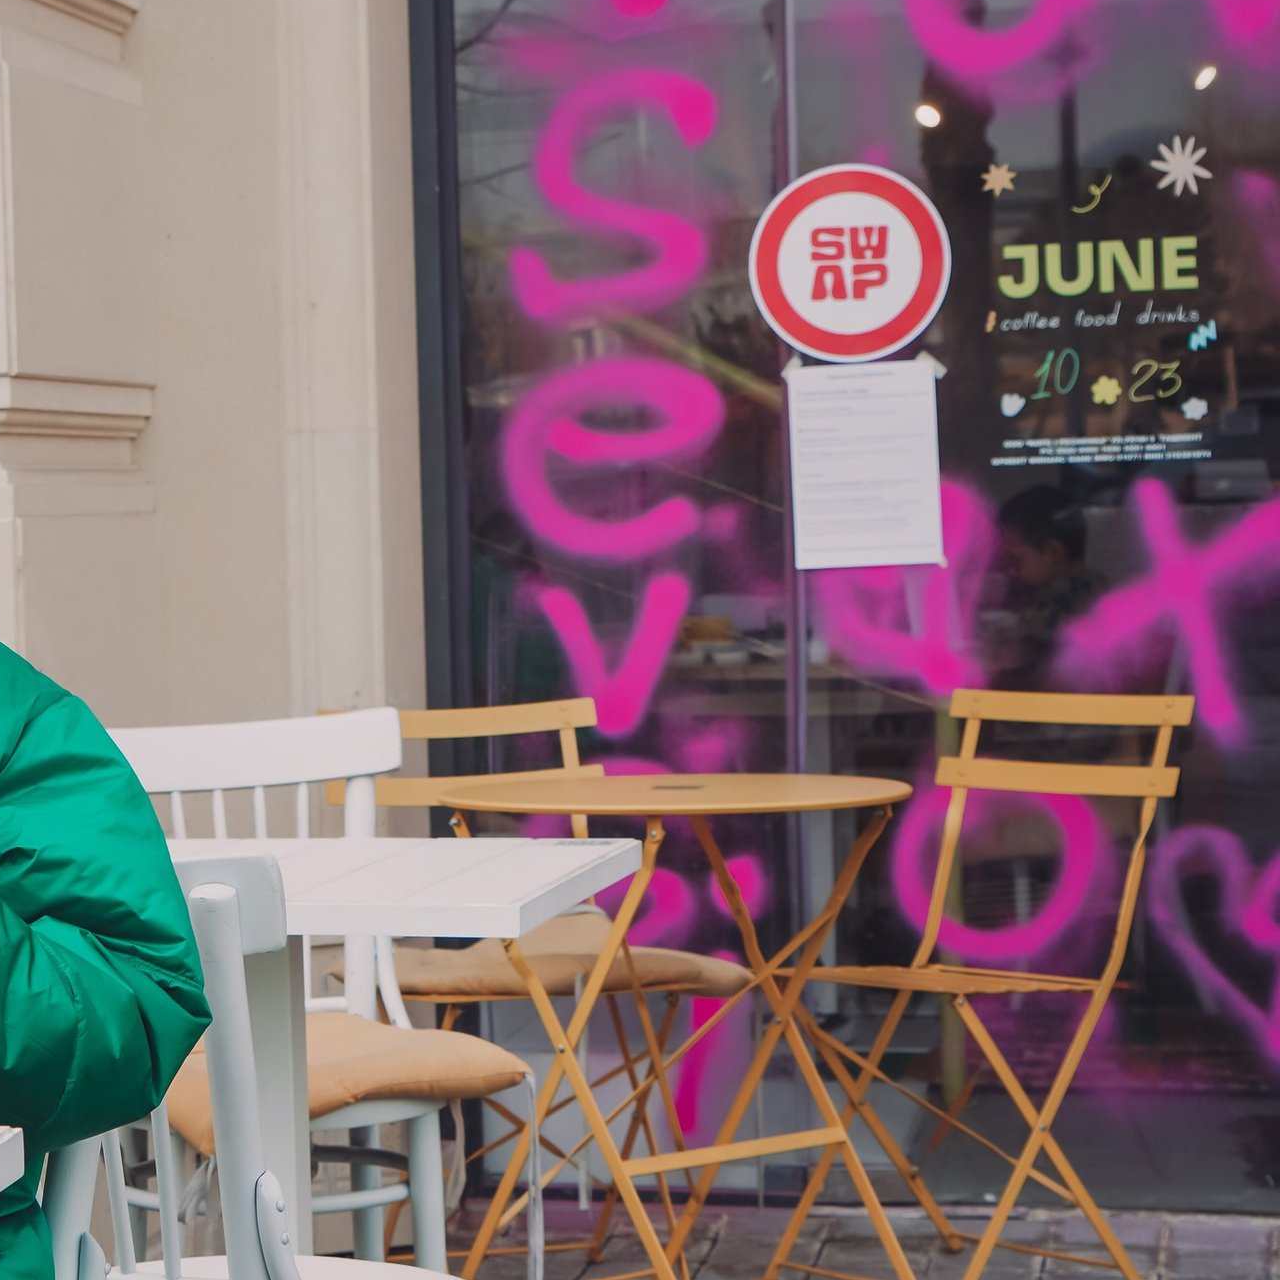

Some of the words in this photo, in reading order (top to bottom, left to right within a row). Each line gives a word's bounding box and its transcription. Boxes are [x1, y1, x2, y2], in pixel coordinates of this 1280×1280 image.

[997, 235, 1200, 300] JUNE
[1000, 311, 1061, 332] coffee
[1074, 299, 1122, 328] food
[1136, 297, 1201, 326] drinks
[1030, 347, 1081, 401] 10
[1128, 358, 1183, 403] 23
